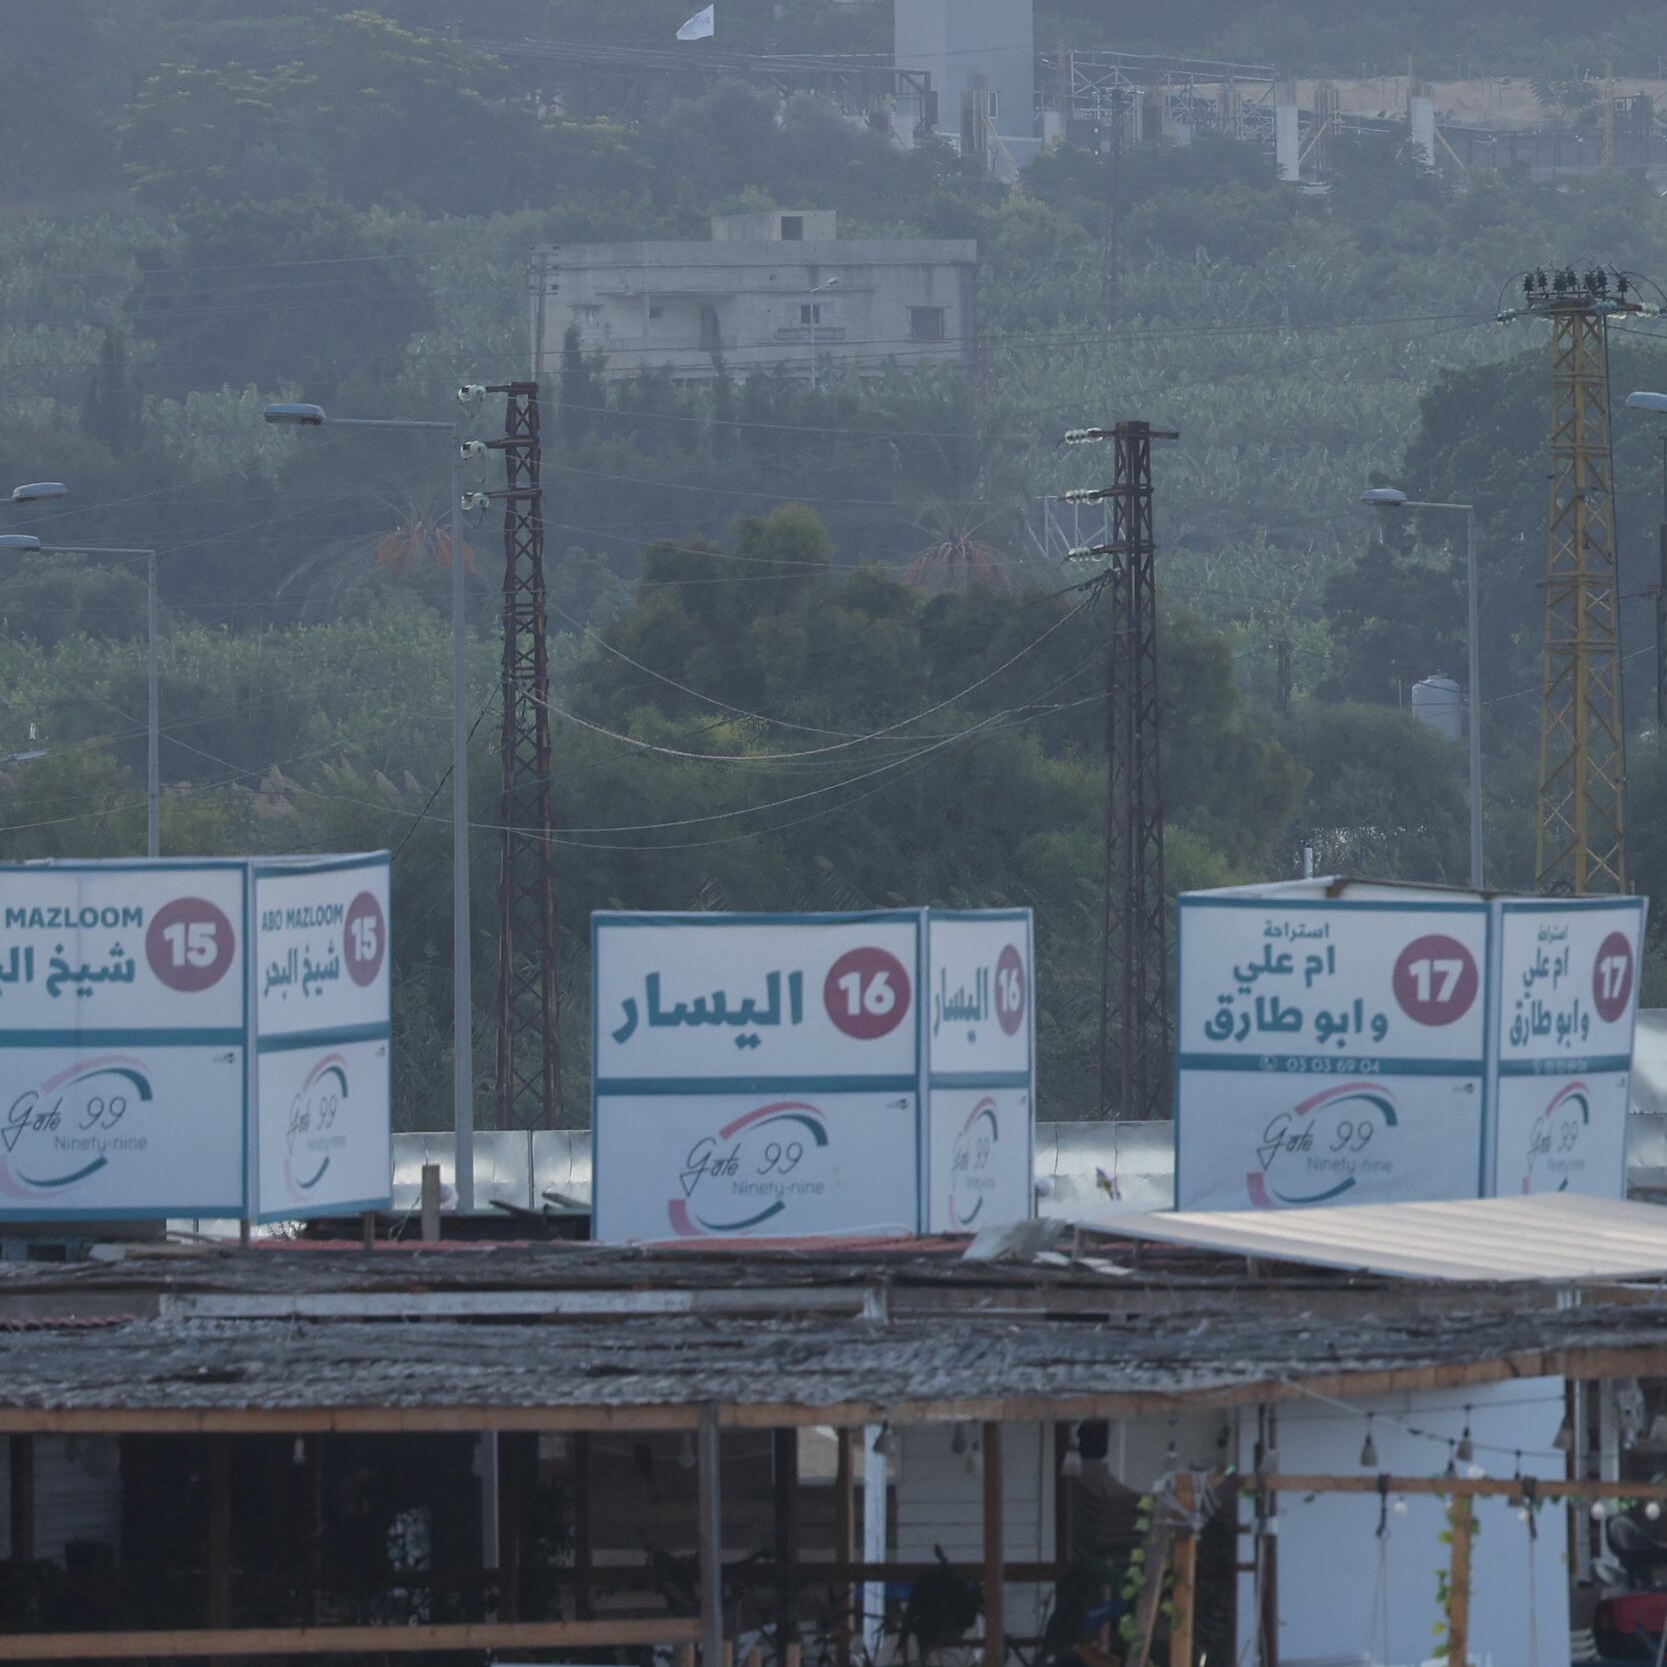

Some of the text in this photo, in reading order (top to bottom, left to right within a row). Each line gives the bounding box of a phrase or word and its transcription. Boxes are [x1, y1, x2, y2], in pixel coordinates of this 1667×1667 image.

[5, 907, 143, 928] MAZLOOM
[262, 903, 343, 931] ABO MAZLOOM
[351, 915, 378, 961] 15
[1263, 920, 1329, 941] استراحة
[163, 922, 218, 968] 15
[46, 942, 135, 999] شيخ
[264, 939, 339, 1001] شيخ البحر
[999, 968, 1019, 1012] 16
[1233, 943, 1335, 995] ام علي
[1408, 959, 1464, 1002] 17
[1553, 947, 1569, 991] ام
[1600, 955, 1628, 999] 17
[611, 970, 803, 1050] اليسار
[838, 970, 896, 1016] 16
[934, 966, 989, 1043] اليسار
[1204, 994, 1304, 1042] طارق
[1510, 999, 1551, 1047] طارق
[1, 1090, 126, 1152] Gate 99
[54, 1135, 147, 1152] Ninety-nine
[1330, 1120, 1374, 1152] 99
[679, 1137, 803, 1197] Gate 99
[1307, 1156, 1393, 1174] Ninety-nine
[732, 1180, 824, 1197] Ninety-nine
